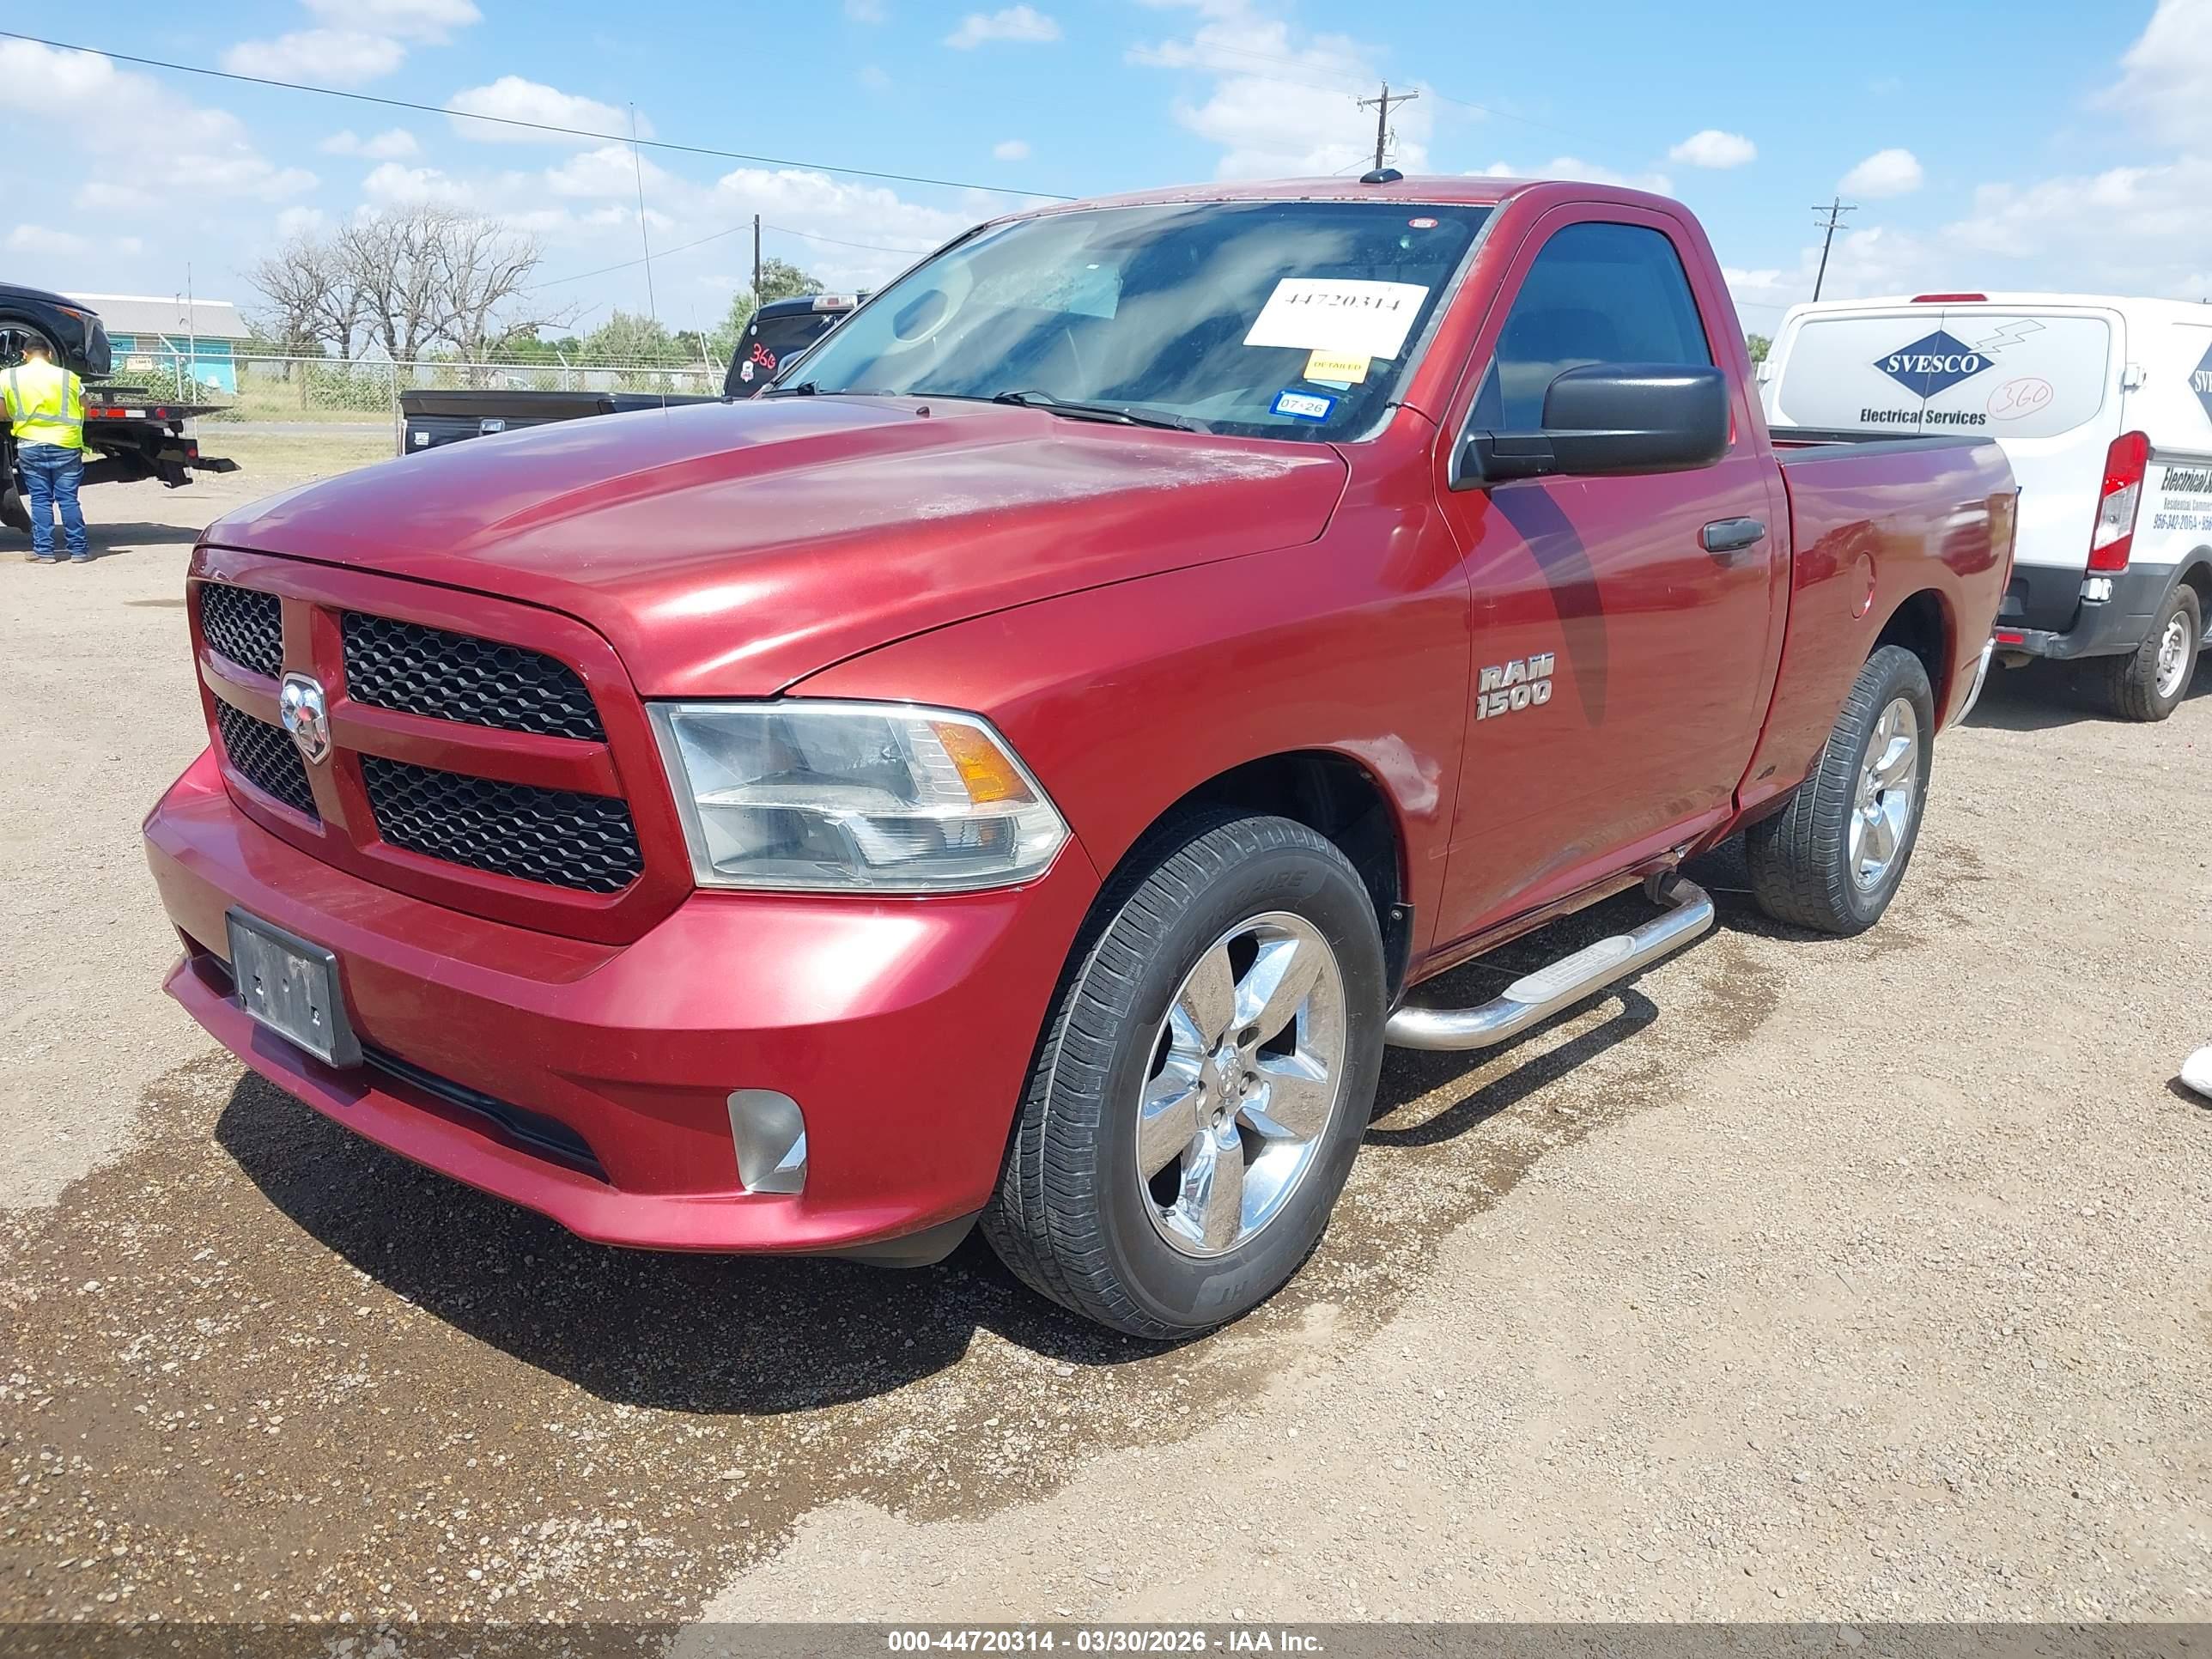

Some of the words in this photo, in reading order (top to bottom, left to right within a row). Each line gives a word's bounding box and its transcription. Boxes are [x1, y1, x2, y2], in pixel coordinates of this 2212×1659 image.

[1285, 293, 1401, 312] 44720314
[1887, 354, 1979, 373] SVESCO
[1996, 385, 2049, 413] 360
[1860, 408, 1923, 423] Electrical
[1925, 409, 1987, 425] Services
[2160, 466, 2209, 492] Electrical
[1480, 652, 1555, 693] RAM
[1476, 679, 1553, 721] 1500
